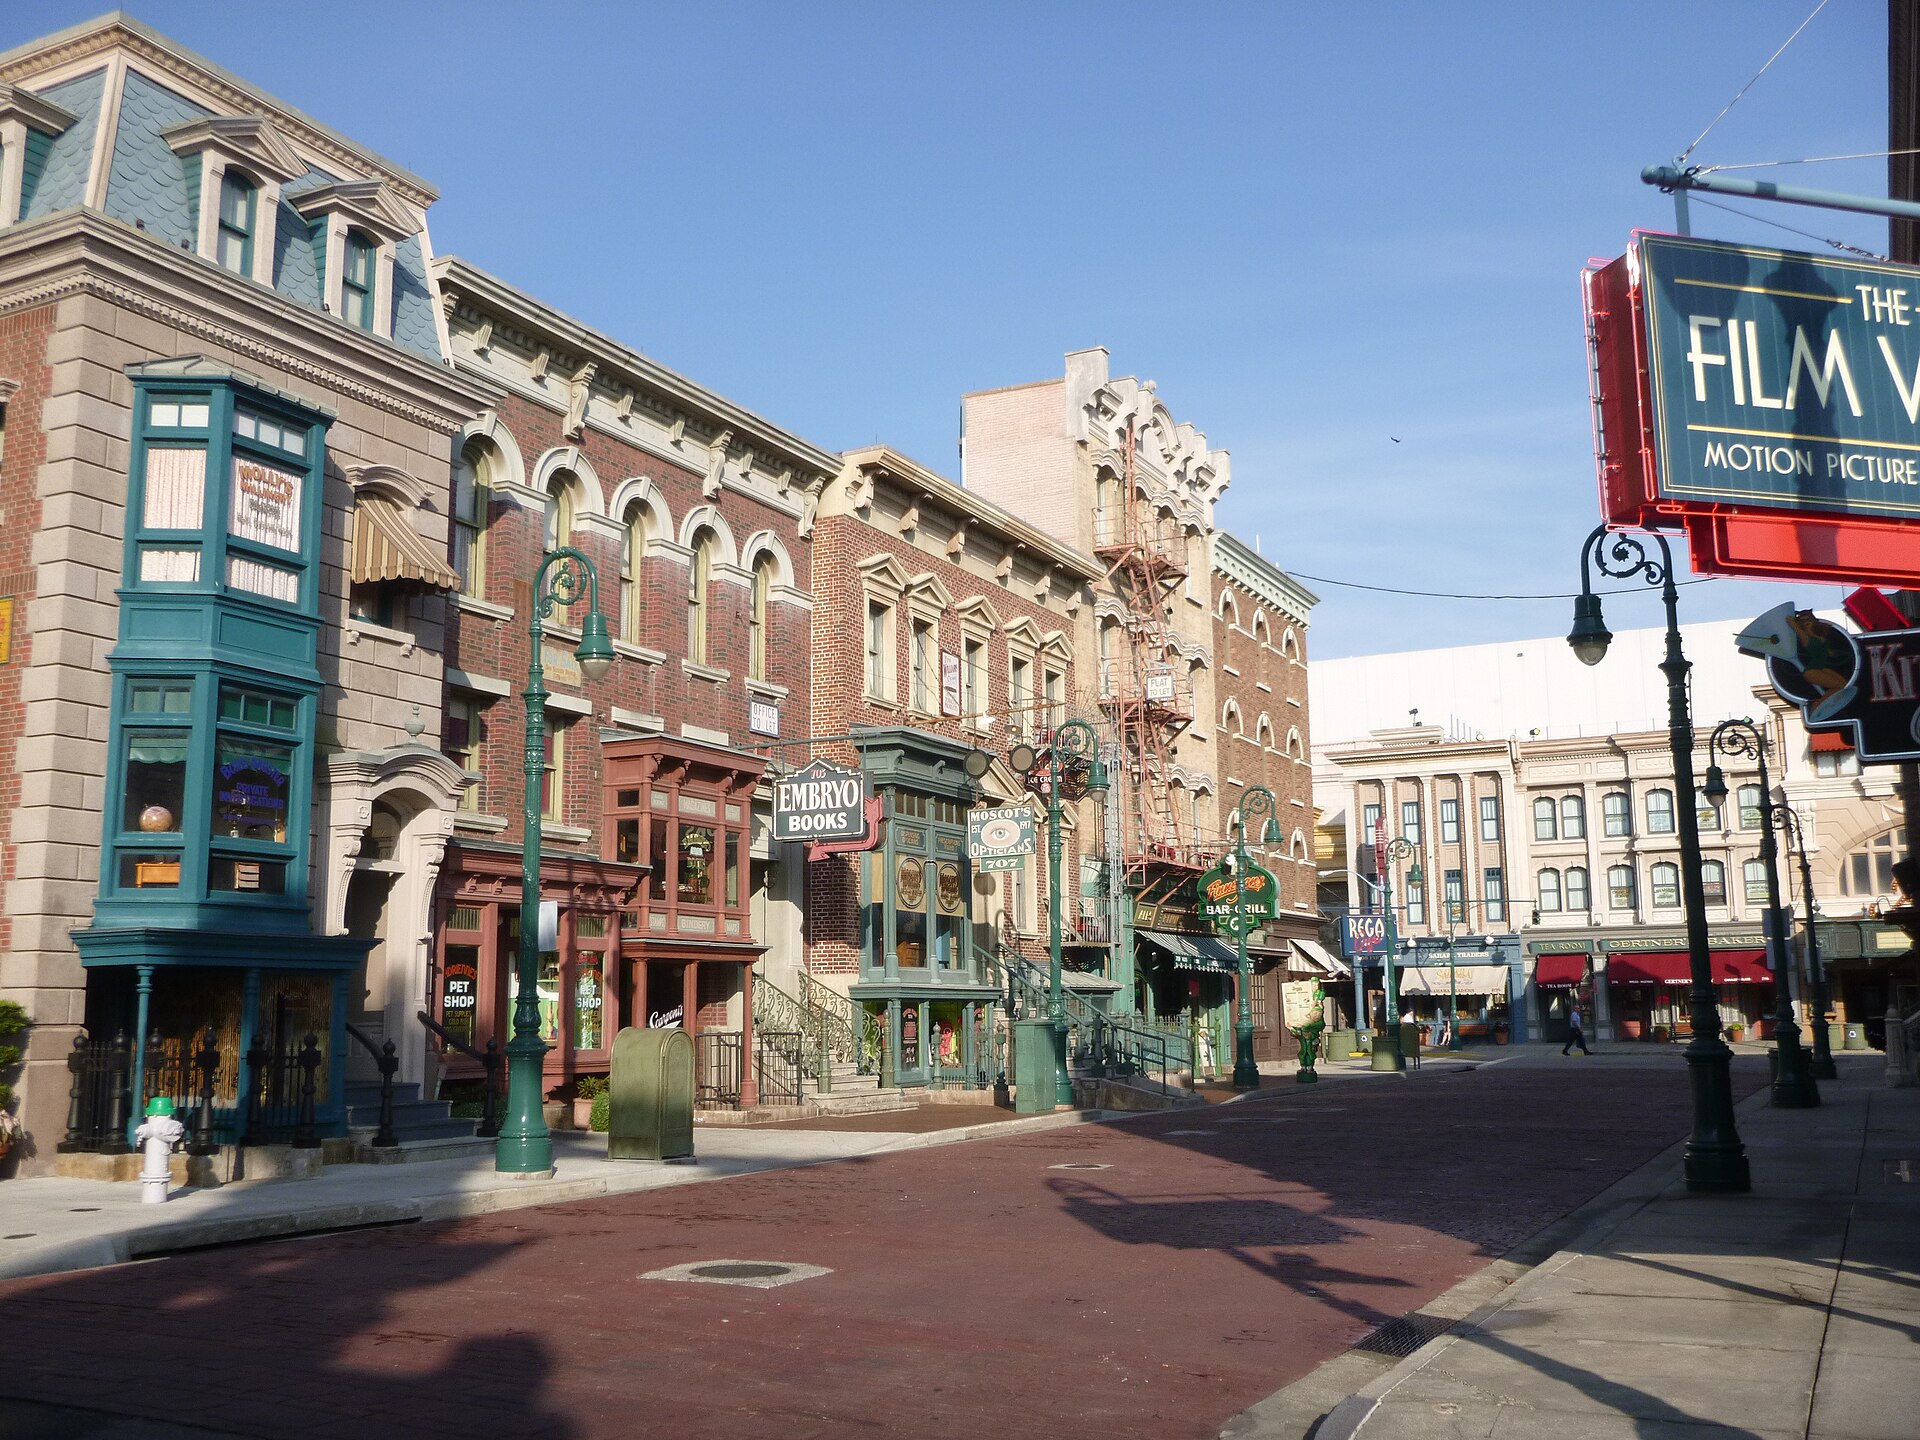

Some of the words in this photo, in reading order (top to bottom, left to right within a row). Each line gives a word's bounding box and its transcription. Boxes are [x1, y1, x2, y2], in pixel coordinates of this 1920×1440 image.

[1855, 285, 1910, 326] THE
[1686, 314, 1863, 417] FILM
[1704, 441, 1814, 477] MOTION
[1826, 453, 1919, 486] PICTURE
[239, 465, 294, 497] MOLLY'S
[1150, 677, 1168, 687] FLAT
[1159, 687, 1170, 695] LET
[753, 703, 776, 719] OFFICE
[752, 716, 761, 729] TO
[765, 718, 776, 732] LET
[1027, 776, 1038, 784] ICE
[1039, 775, 1063, 784] CREM
[236, 782, 270, 797] PRIVATE
[778, 778, 859, 813] EMBRYO
[971, 806, 1031, 822] MOSCOT'S
[788, 813, 848, 832] BOOKS
[1019, 820, 1031, 830] 1917
[971, 837, 1032, 856] OPTICIANS
[985, 858, 1019, 869] 707
[681, 918, 712, 931] BINDERY
[1349, 917, 1385, 938] REGA
[1539, 943, 1556, 951] TEA
[1560, 942, 1586, 950] ROOM
[1609, 938, 1688, 948] GERTNER'
[1707, 936, 1768, 945] BAKER
[1457, 951, 1489, 959] TRADERS
[449, 981, 470, 993] PET
[580, 984, 597, 995] PET
[444, 996, 475, 1008] SHOP
[576, 997, 601, 1009] SHOP
